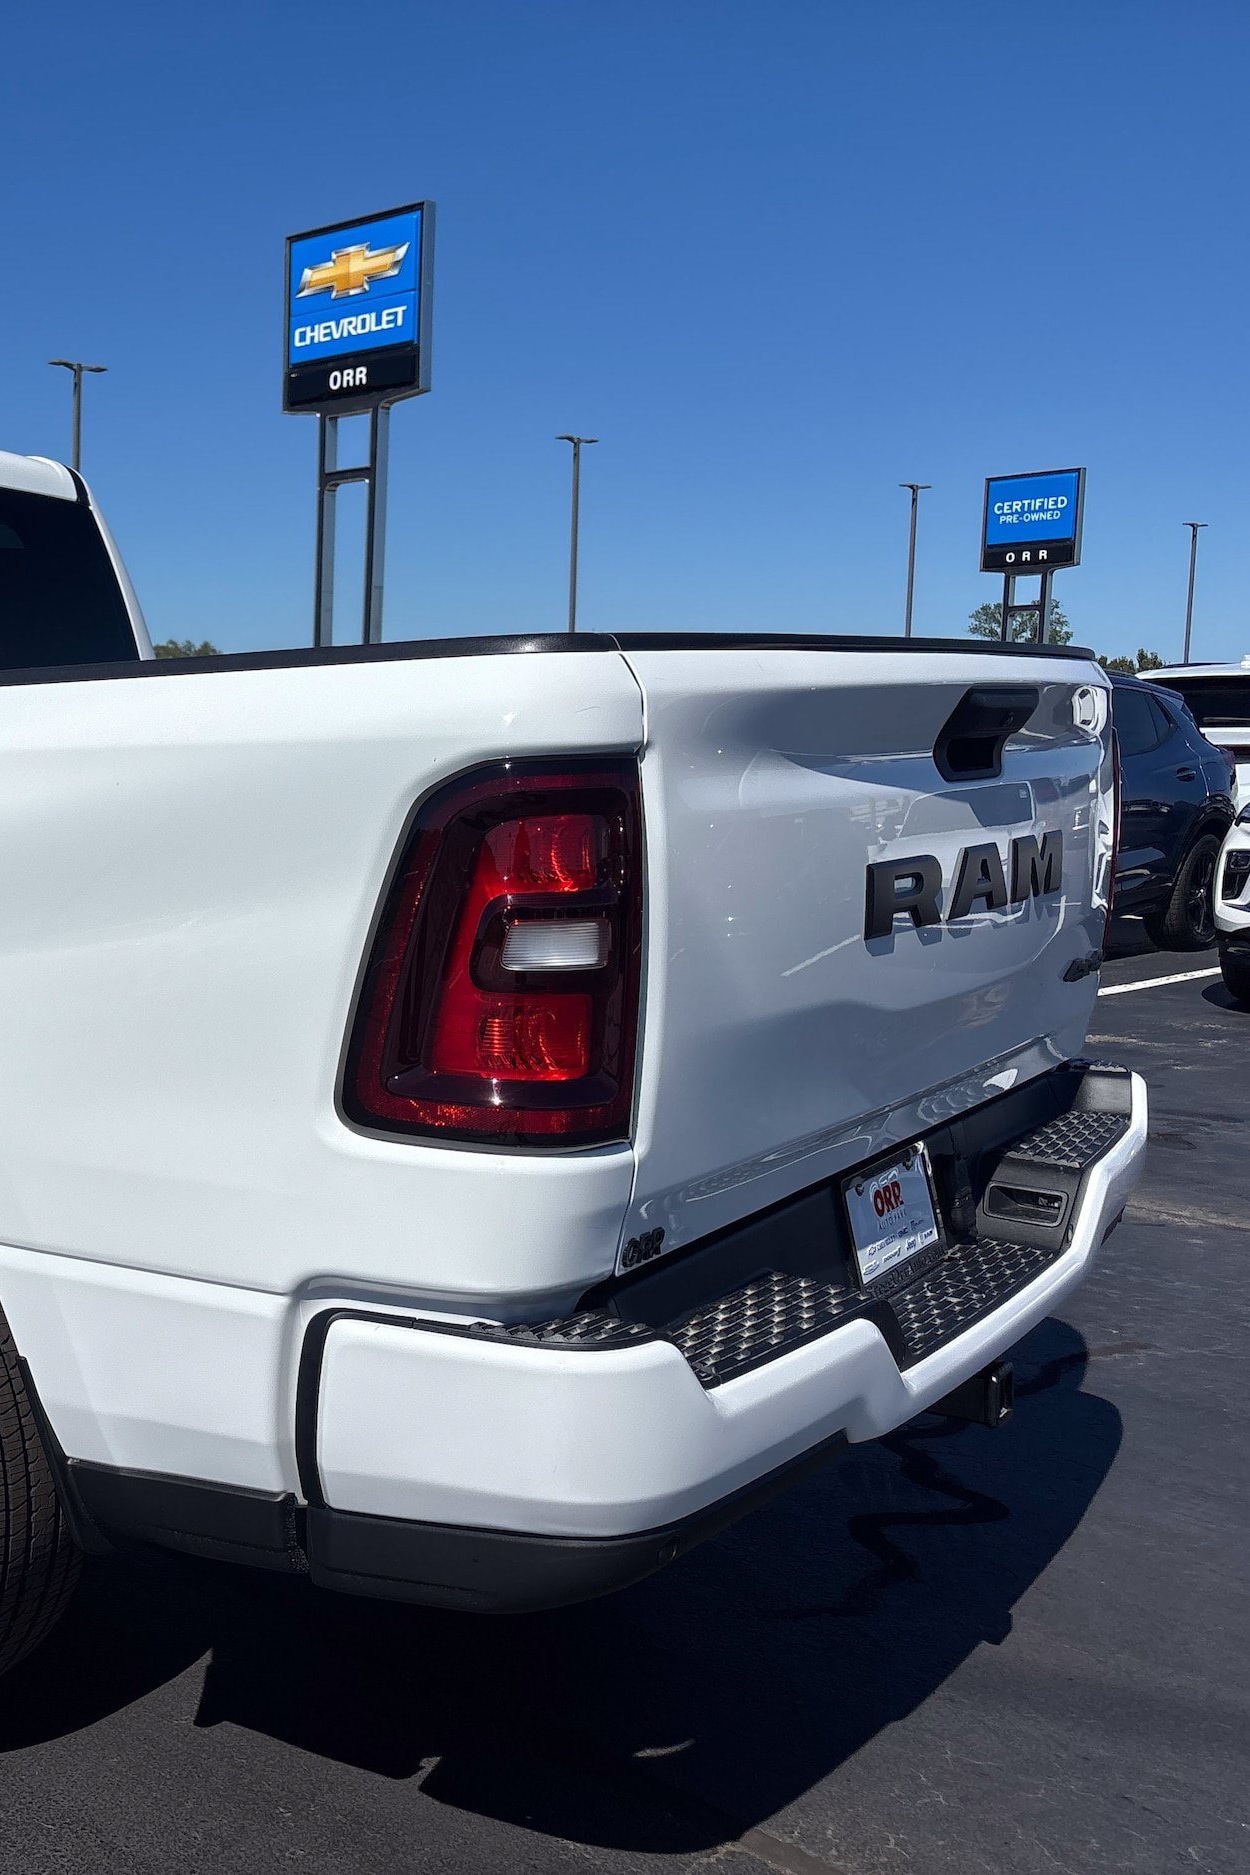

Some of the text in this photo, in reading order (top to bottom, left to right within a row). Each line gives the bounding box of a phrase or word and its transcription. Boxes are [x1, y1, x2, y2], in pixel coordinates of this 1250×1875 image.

[294, 305, 407, 347] CHEVROLET
[329, 366, 368, 391] ORR
[994, 496, 1068, 515] CERTIFIED
[999, 510, 1061, 524] PRE-OWNED
[863, 829, 1063, 941] RAM
[873, 1180, 905, 1218] ORR
